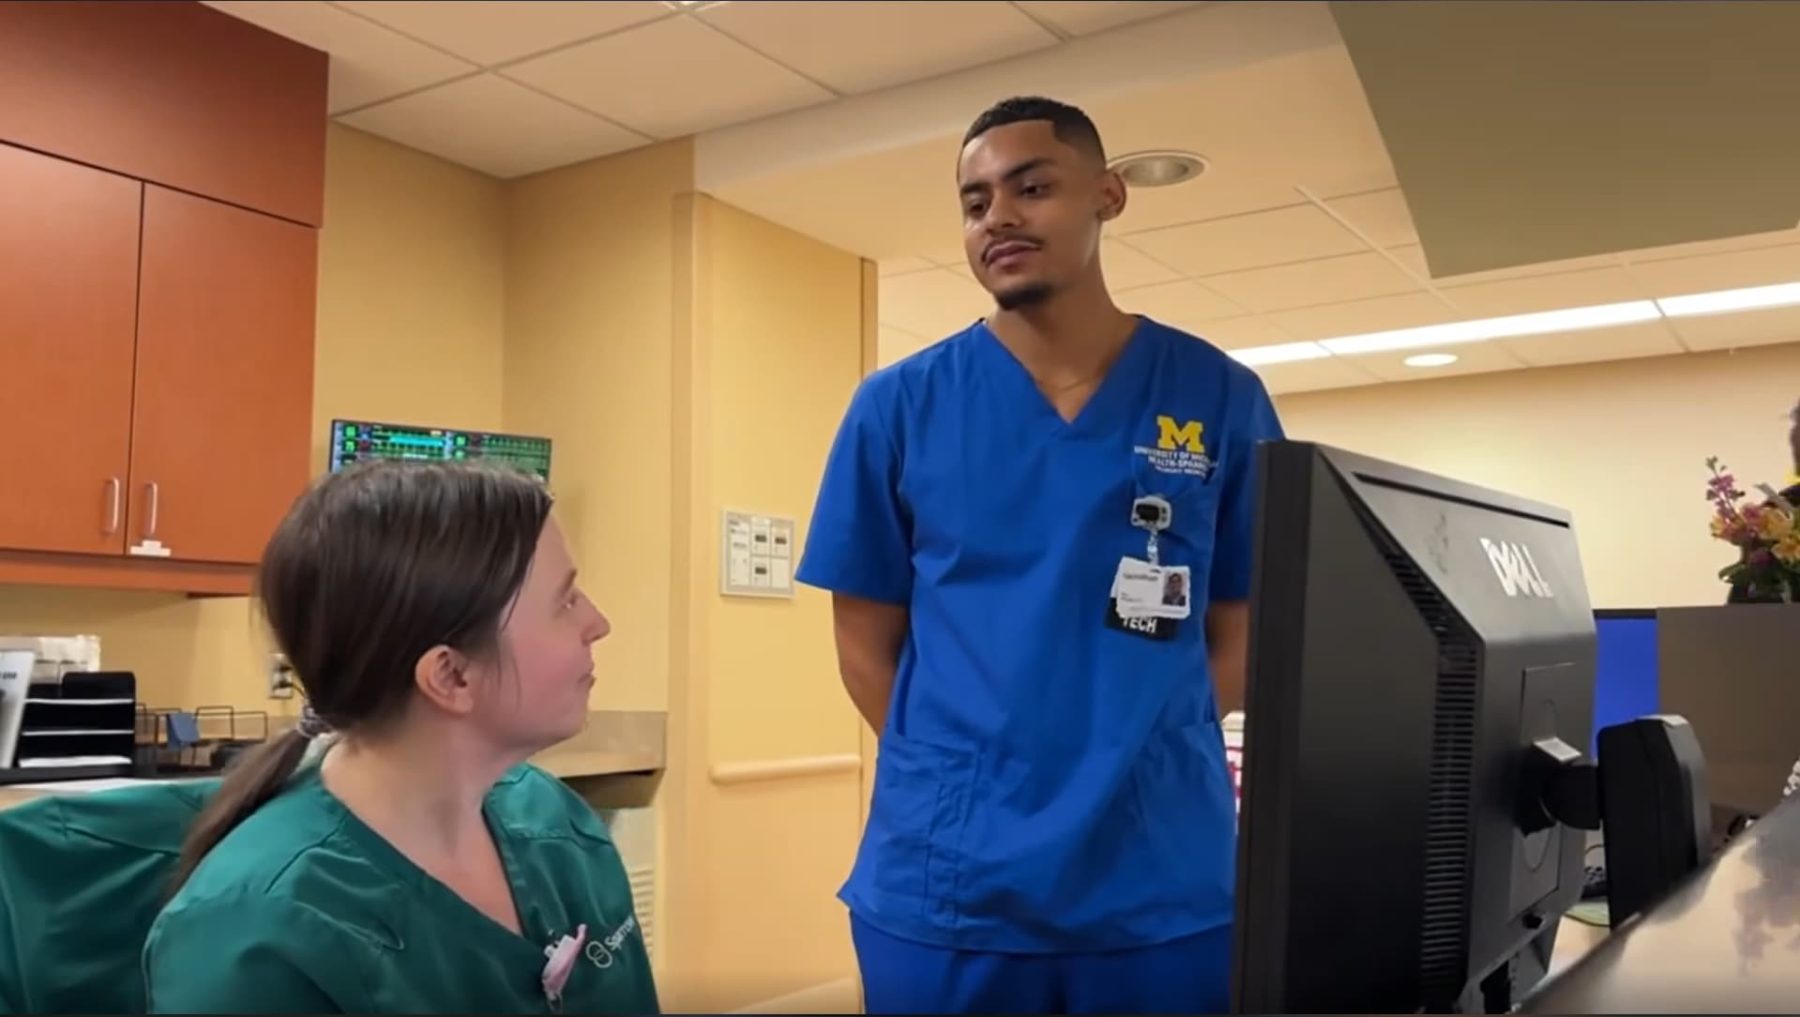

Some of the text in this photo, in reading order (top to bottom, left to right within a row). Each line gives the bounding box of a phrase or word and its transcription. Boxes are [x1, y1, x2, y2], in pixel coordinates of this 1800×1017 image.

[1157, 415, 1205, 454] M
[1480, 537, 1553, 597] DELL
[1122, 616, 1158, 634] TECH
